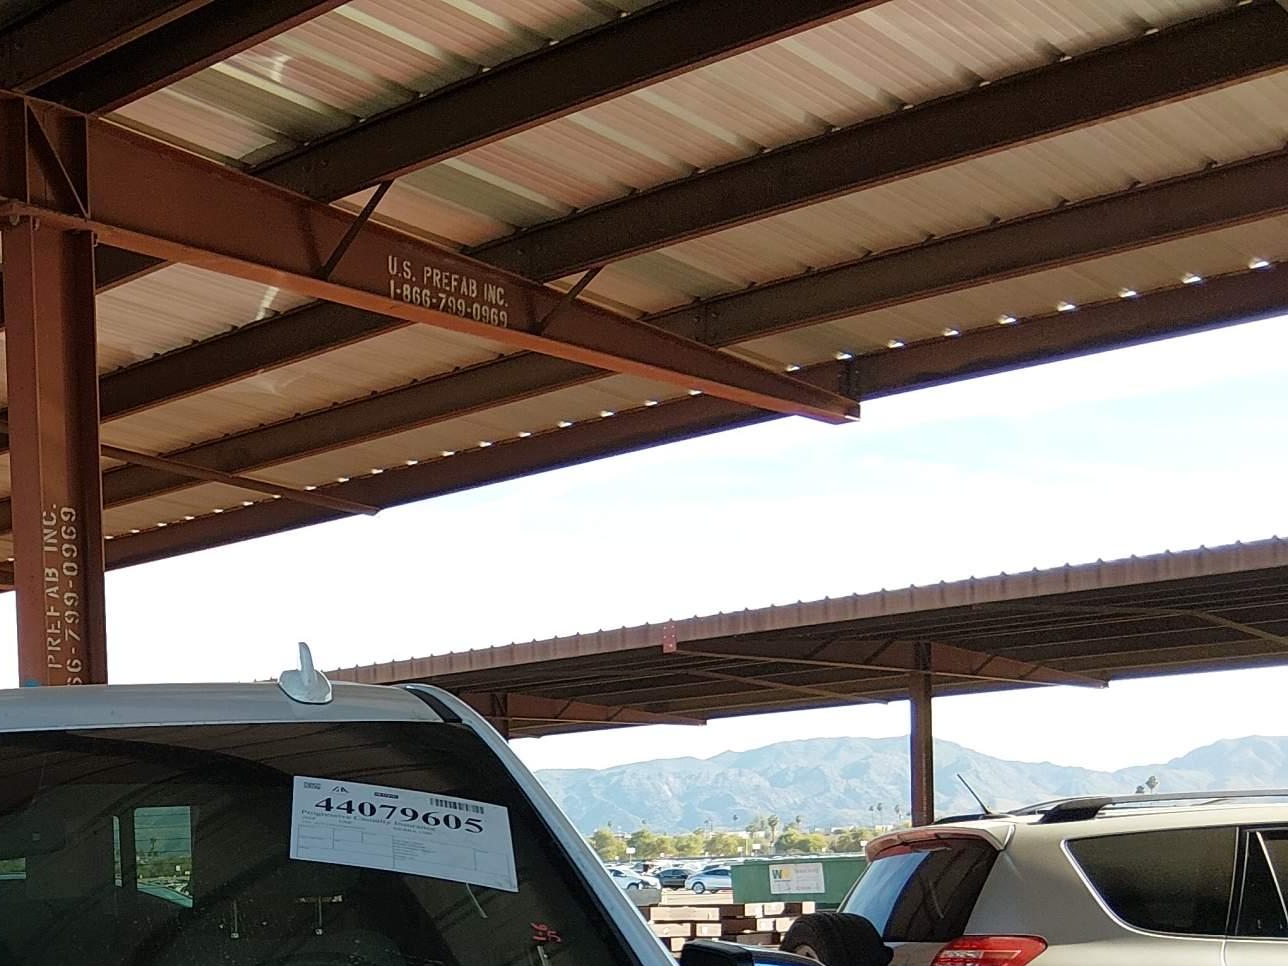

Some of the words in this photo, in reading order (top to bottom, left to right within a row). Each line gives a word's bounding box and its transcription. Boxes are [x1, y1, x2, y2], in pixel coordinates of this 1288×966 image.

[388, 255, 416, 282] U.S.
[423, 266, 478, 298] PREFAB
[484, 283, 509, 308] INC.
[390, 279, 508, 328] 1-866-799-0969
[42, 504, 59, 552] INC.
[45, 567, 62, 668] PREFAB
[314, 797, 484, 834] 44079605
